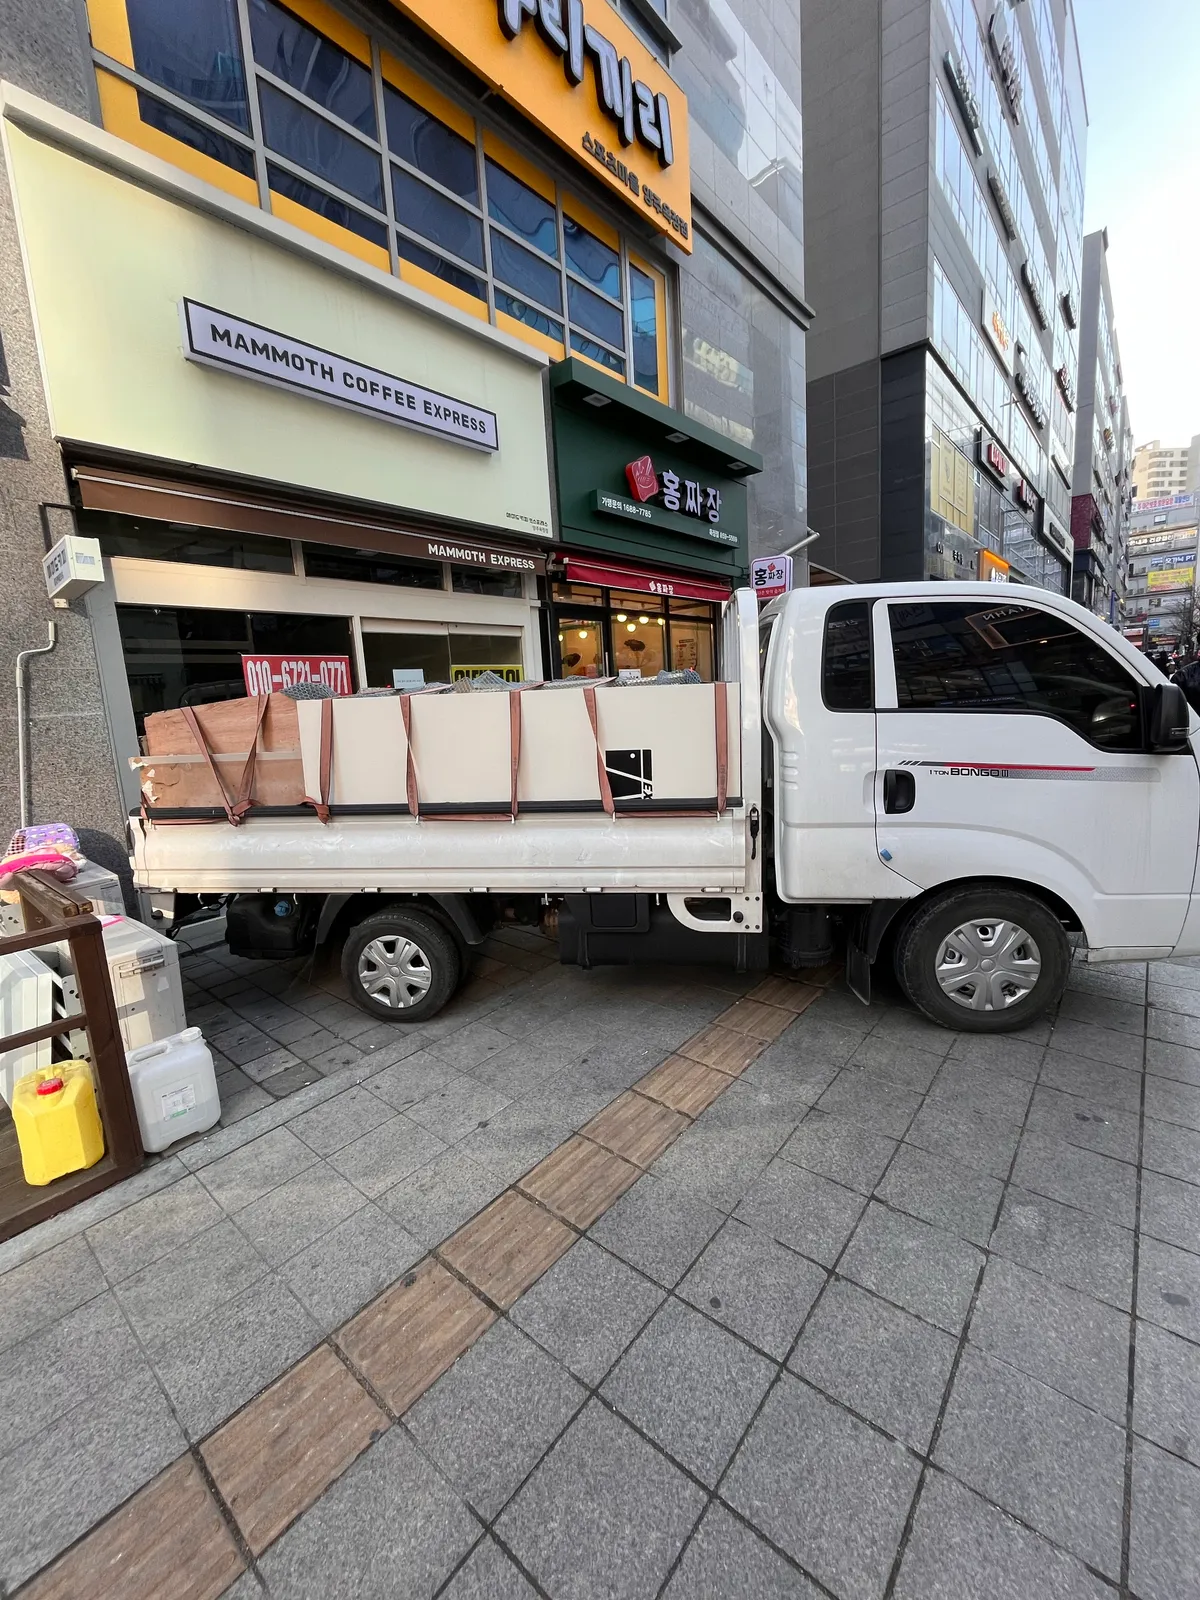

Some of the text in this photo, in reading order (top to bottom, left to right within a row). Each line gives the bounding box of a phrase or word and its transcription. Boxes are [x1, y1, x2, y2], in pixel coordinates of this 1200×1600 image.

[210, 324, 487, 434] MAMMOTH COFFEE EXPRESS
[662, 469, 723, 523] 홍짜장
[428, 543, 535, 570] MAMMOTH EXPRESS
[950, 767, 1000, 777] BONGO
